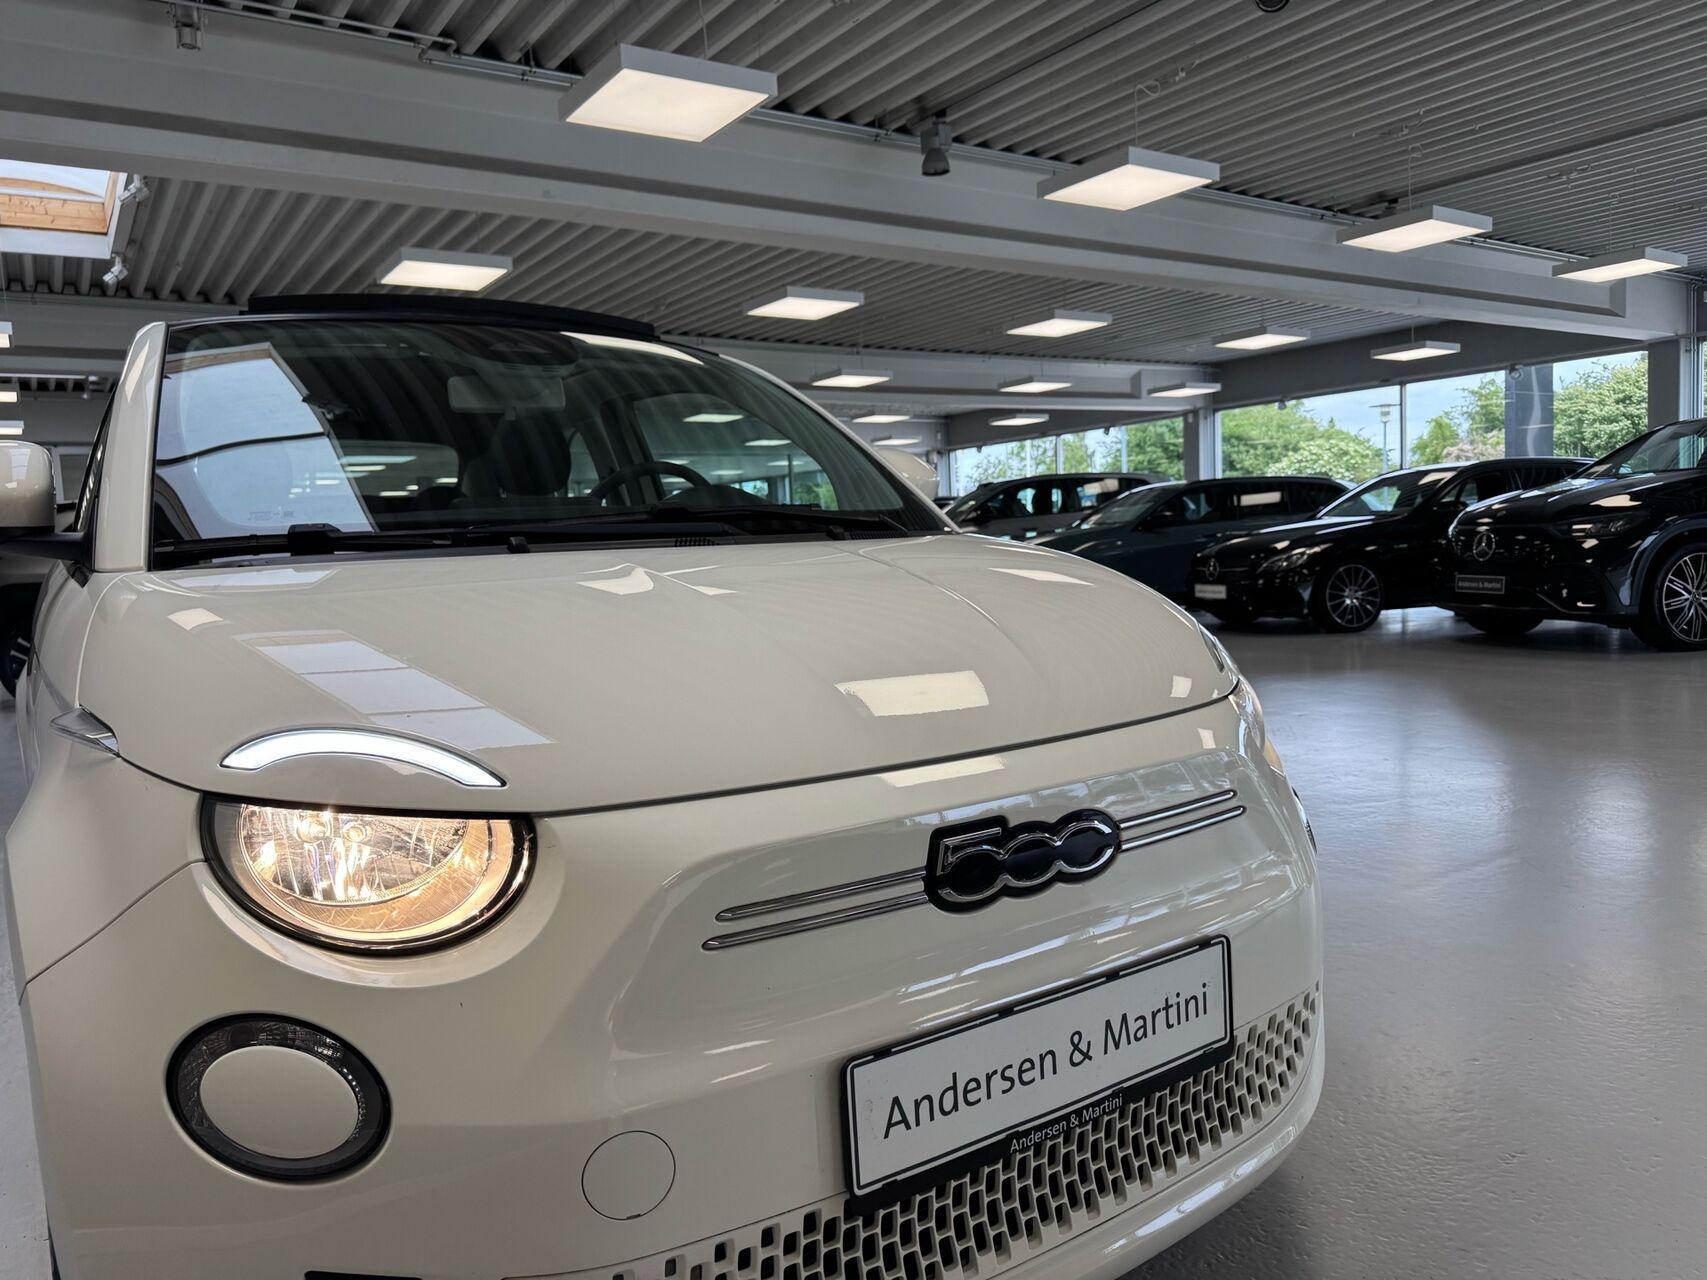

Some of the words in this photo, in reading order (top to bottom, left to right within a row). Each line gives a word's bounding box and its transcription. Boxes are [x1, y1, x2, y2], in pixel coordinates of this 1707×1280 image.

[936, 820, 1115, 903] 500
[883, 1049, 1058, 1140] Andersen
[1069, 1030, 1093, 1068] &
[1103, 982, 1208, 1056] Martini
[1009, 1121, 1067, 1154] Andersen
[1069, 1113, 1080, 1128] &
[1082, 1093, 1123, 1123] Martini
